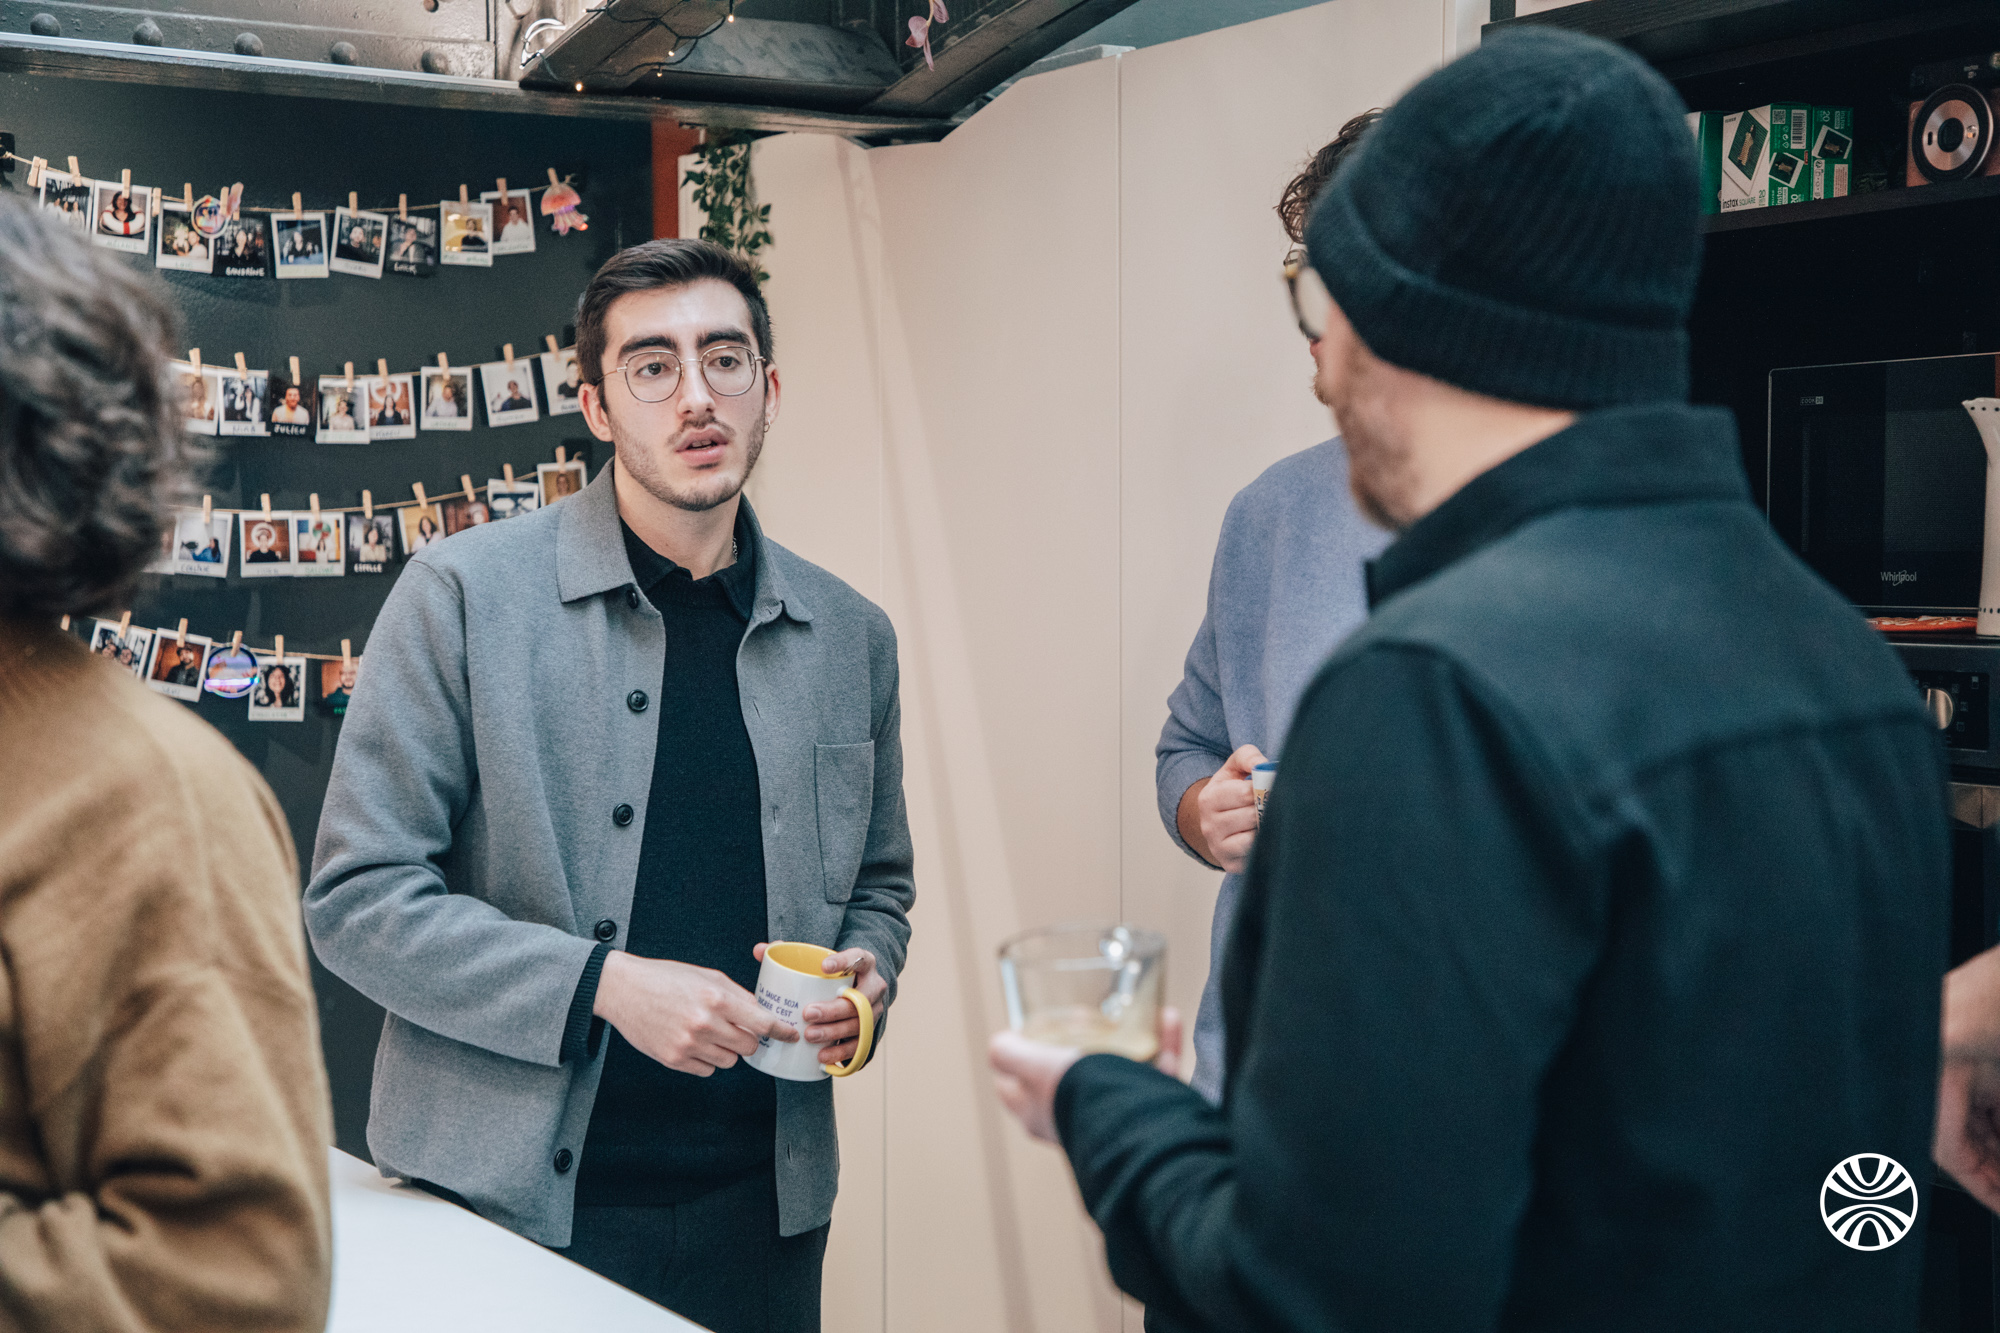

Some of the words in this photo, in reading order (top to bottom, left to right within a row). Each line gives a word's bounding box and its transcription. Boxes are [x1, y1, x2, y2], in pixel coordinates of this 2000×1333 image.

[1758, 189, 1766, 198] 20
[1722, 199, 1738, 209] instax
[1739, 196, 1756, 206] SQUARE
[1880, 571, 1917, 585] Whirlpool
[784, 998, 799, 1009] SOJA
[775, 1006, 793, 1018] C'EST
